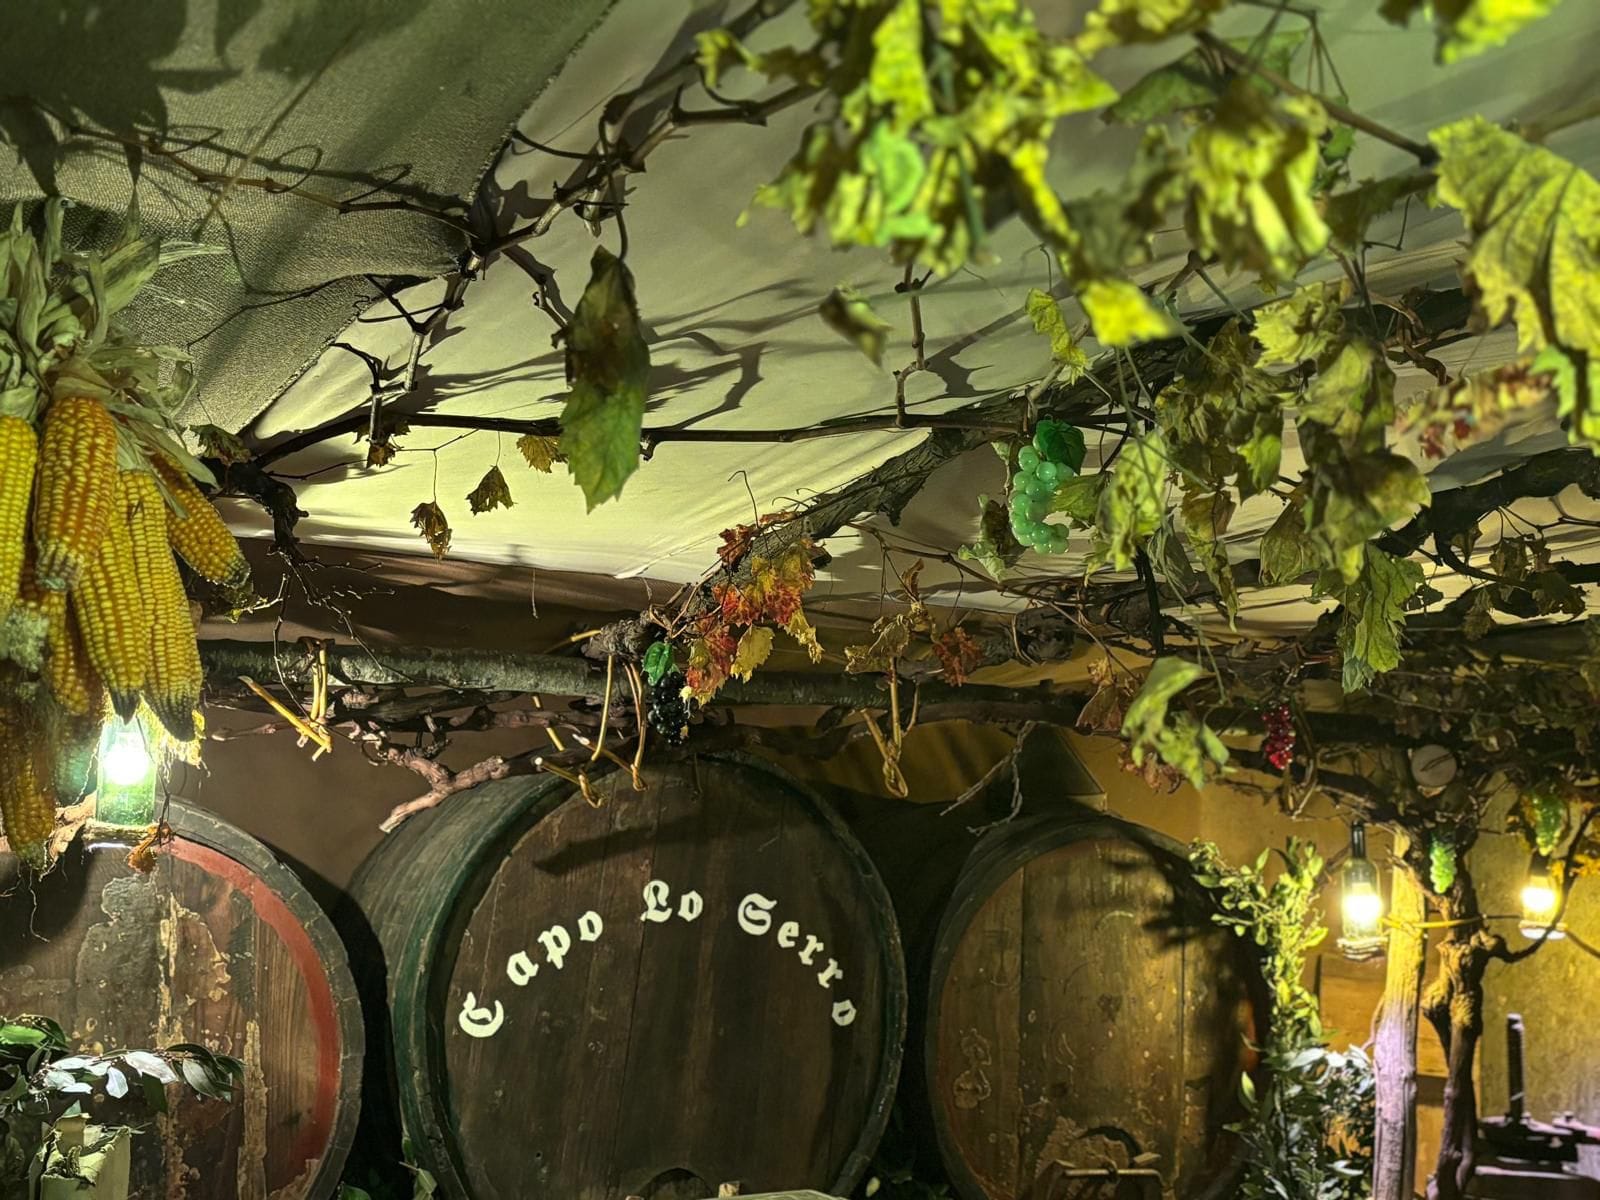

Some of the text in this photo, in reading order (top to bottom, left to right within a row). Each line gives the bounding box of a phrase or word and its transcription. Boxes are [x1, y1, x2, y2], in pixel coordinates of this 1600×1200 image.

[459, 880, 856, 1037] Capo Lo Serro
